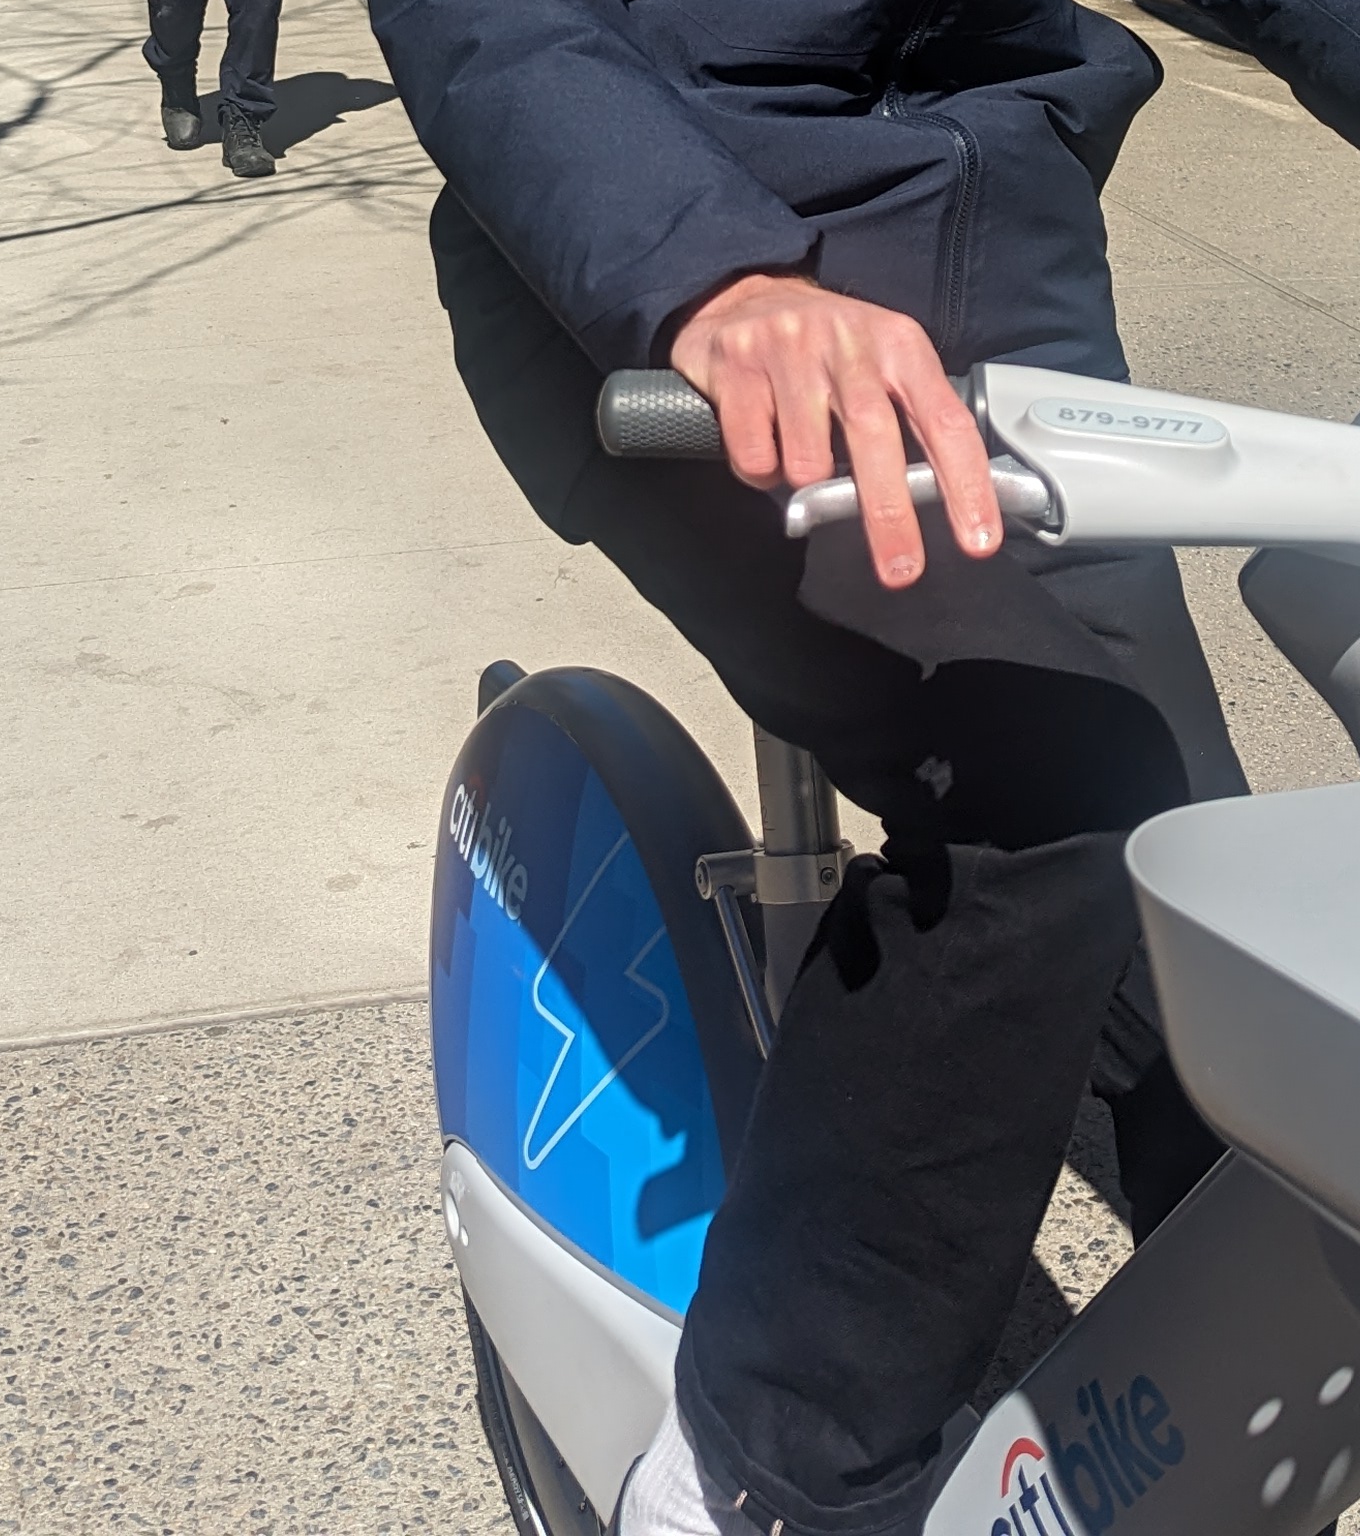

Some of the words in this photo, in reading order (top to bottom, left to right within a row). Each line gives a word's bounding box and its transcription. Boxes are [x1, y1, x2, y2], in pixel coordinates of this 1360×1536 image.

[1058, 407, 1203, 434] 879-9777
[450, 783, 479, 862] citi
[470, 801, 528, 921] bike
[1045, 1374, 1186, 1536] bike
